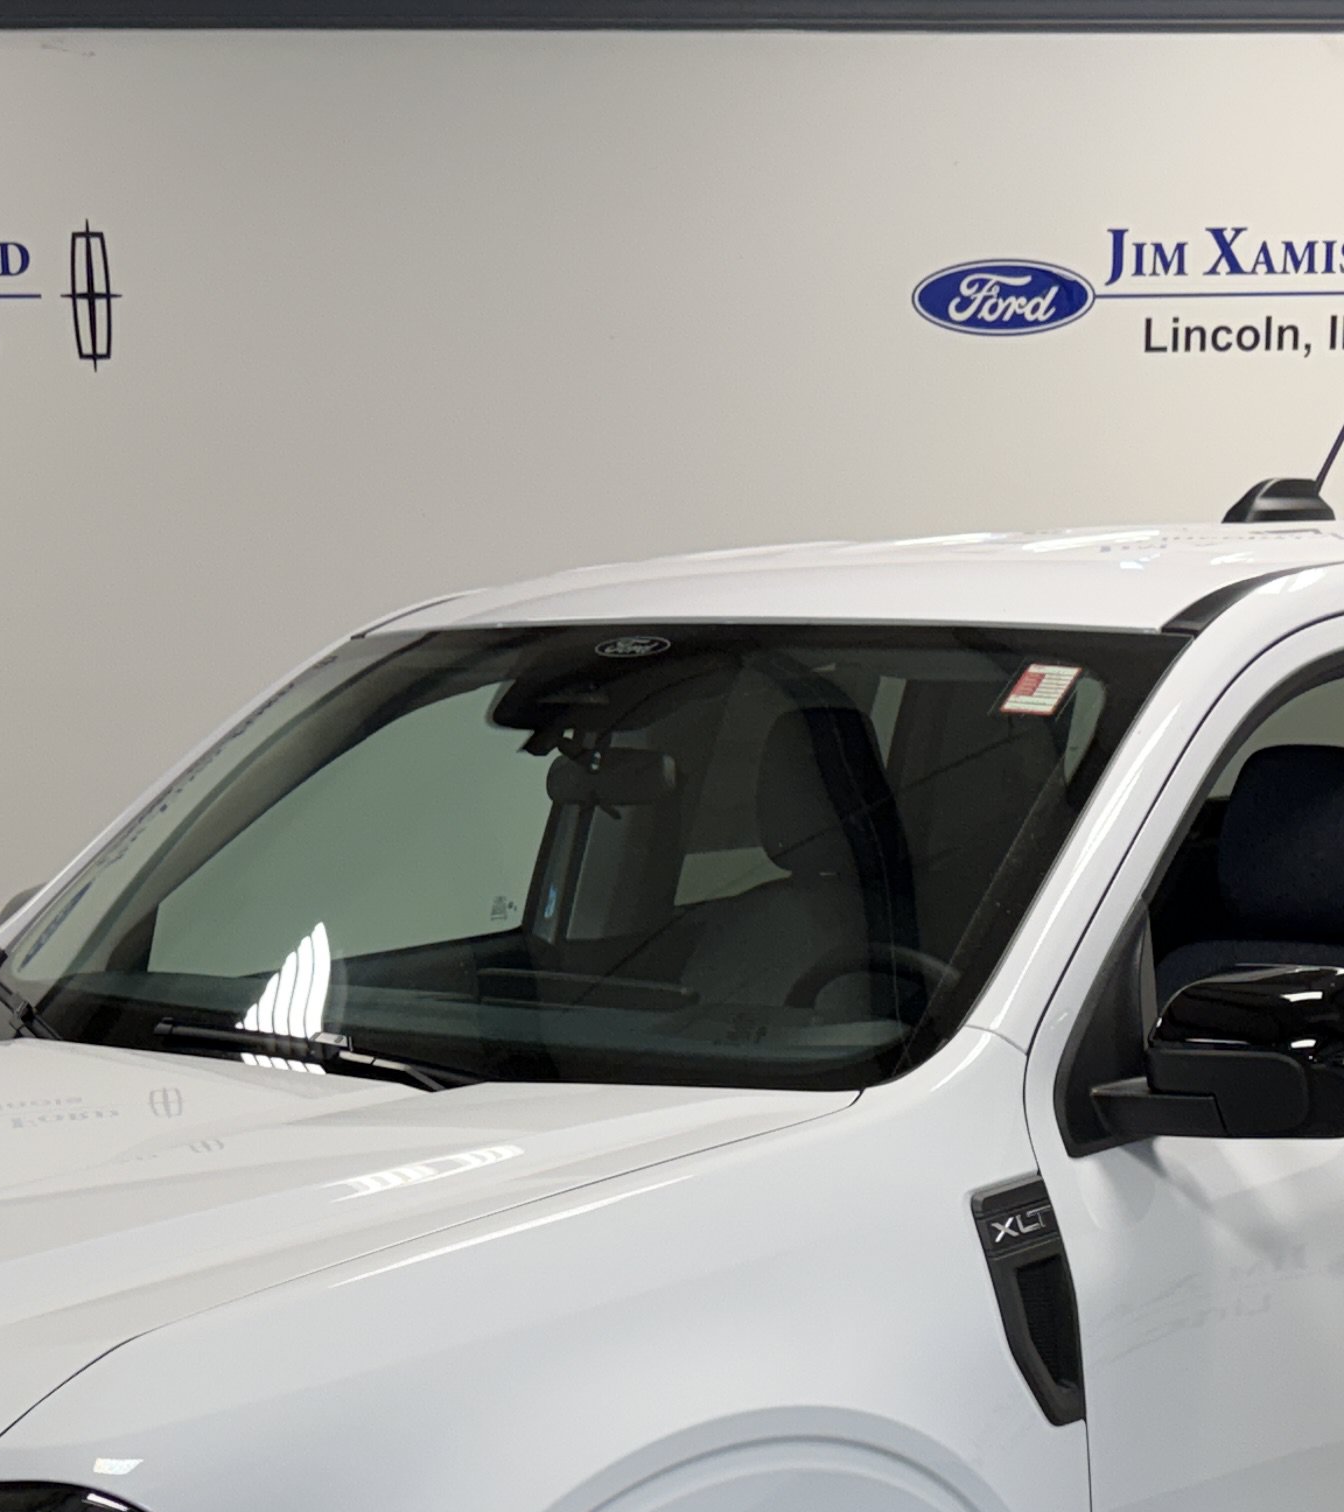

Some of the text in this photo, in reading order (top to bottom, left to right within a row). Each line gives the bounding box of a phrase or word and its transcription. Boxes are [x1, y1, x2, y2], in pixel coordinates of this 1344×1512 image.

[1105, 227, 1188, 286] JIM
[948, 272, 1059, 323] Ford
[1143, 316, 1312, 358] Lincoln,
[990, 1203, 1052, 1244] XLT
